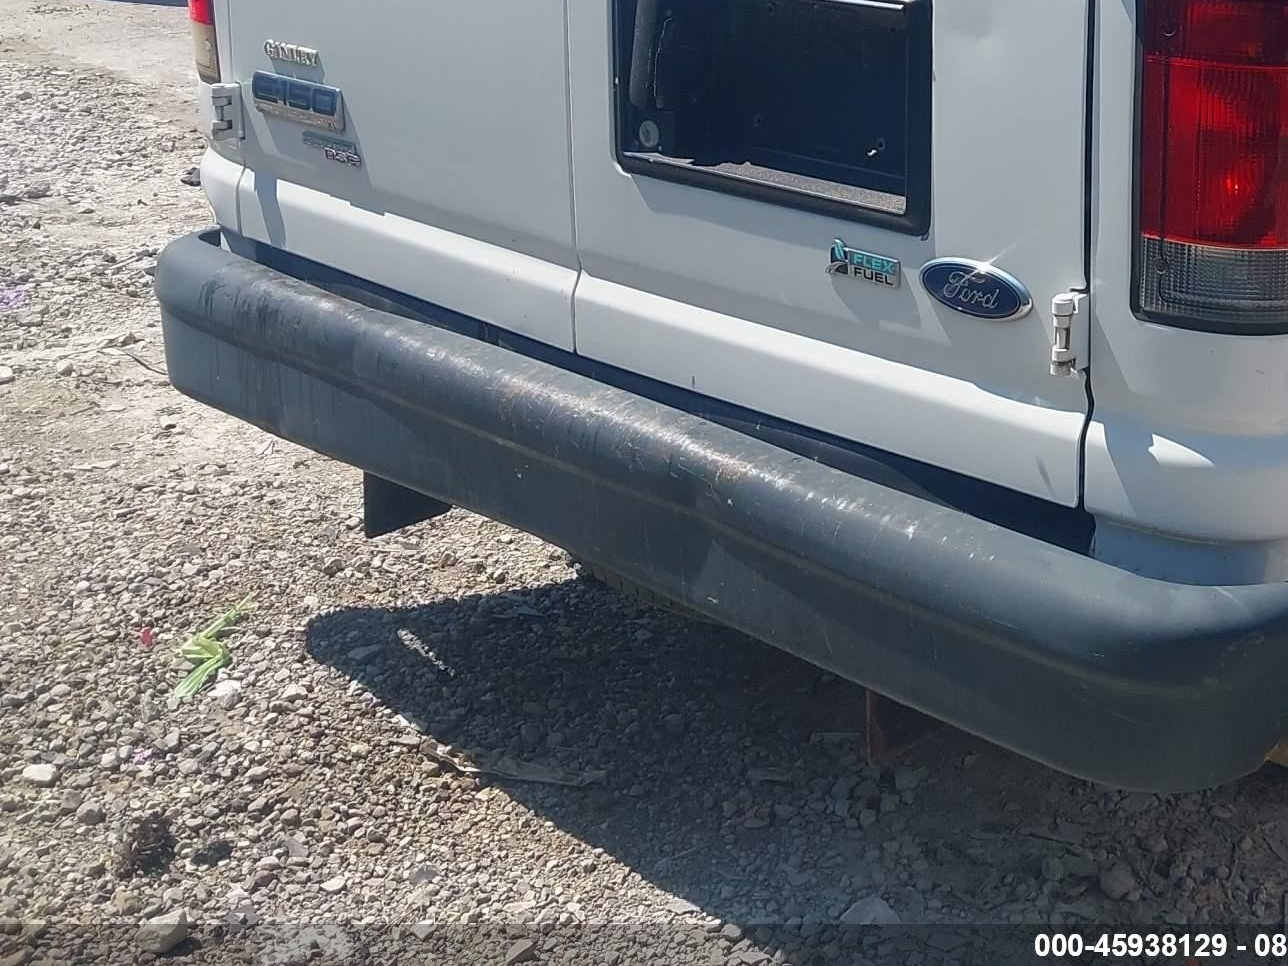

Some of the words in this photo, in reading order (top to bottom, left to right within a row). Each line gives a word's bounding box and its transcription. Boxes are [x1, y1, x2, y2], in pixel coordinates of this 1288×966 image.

[852, 253, 896, 274] FLEX
[852, 266, 894, 286] FUEL
[943, 271, 1000, 309] Ford
